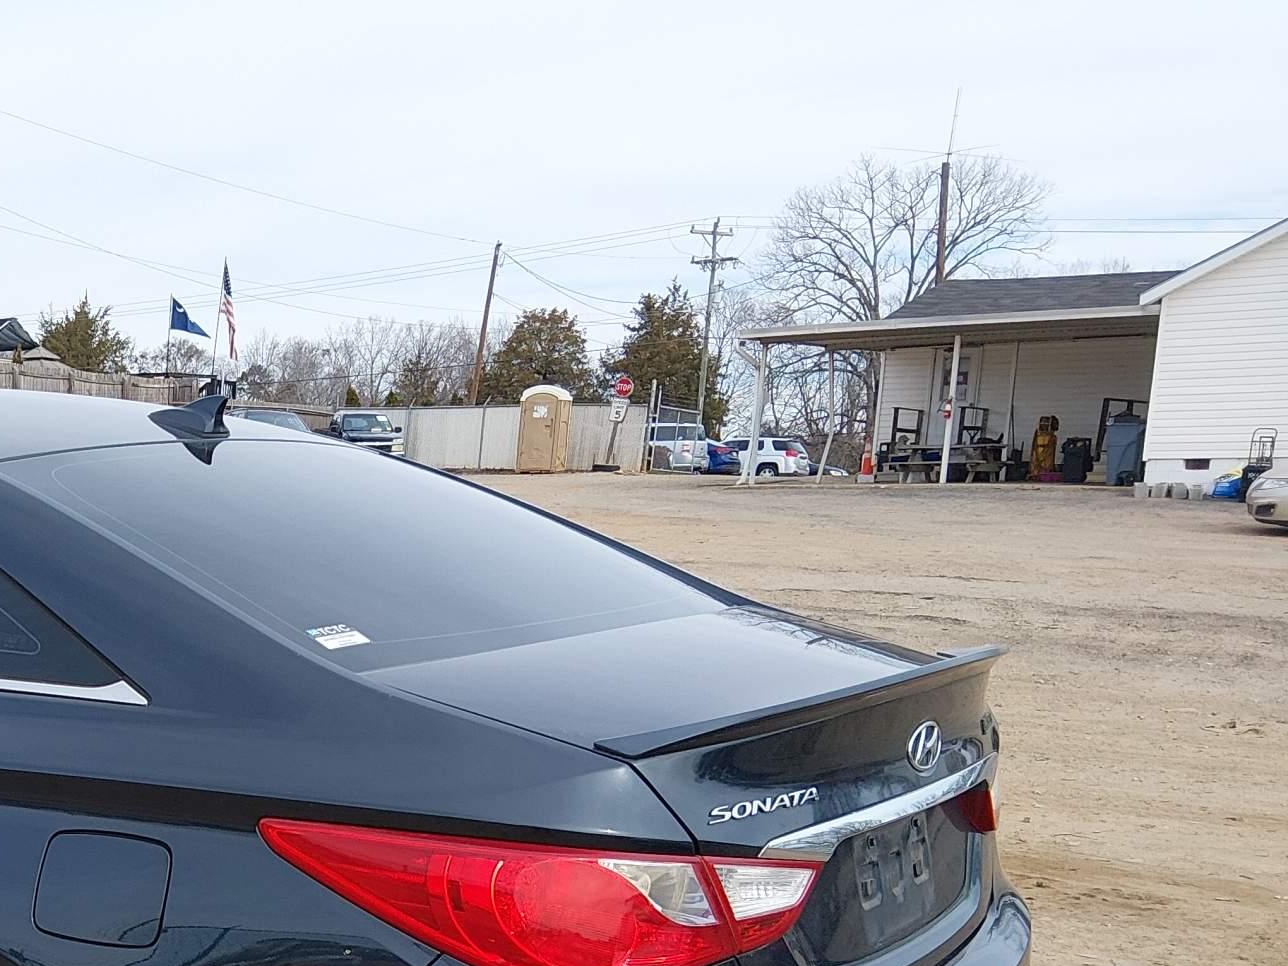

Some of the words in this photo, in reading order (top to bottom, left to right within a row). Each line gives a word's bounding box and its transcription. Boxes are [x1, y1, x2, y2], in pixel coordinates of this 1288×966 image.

[615, 383, 632, 392] STOP
[614, 410, 622, 419] 5
[708, 786, 821, 826] SONATA
